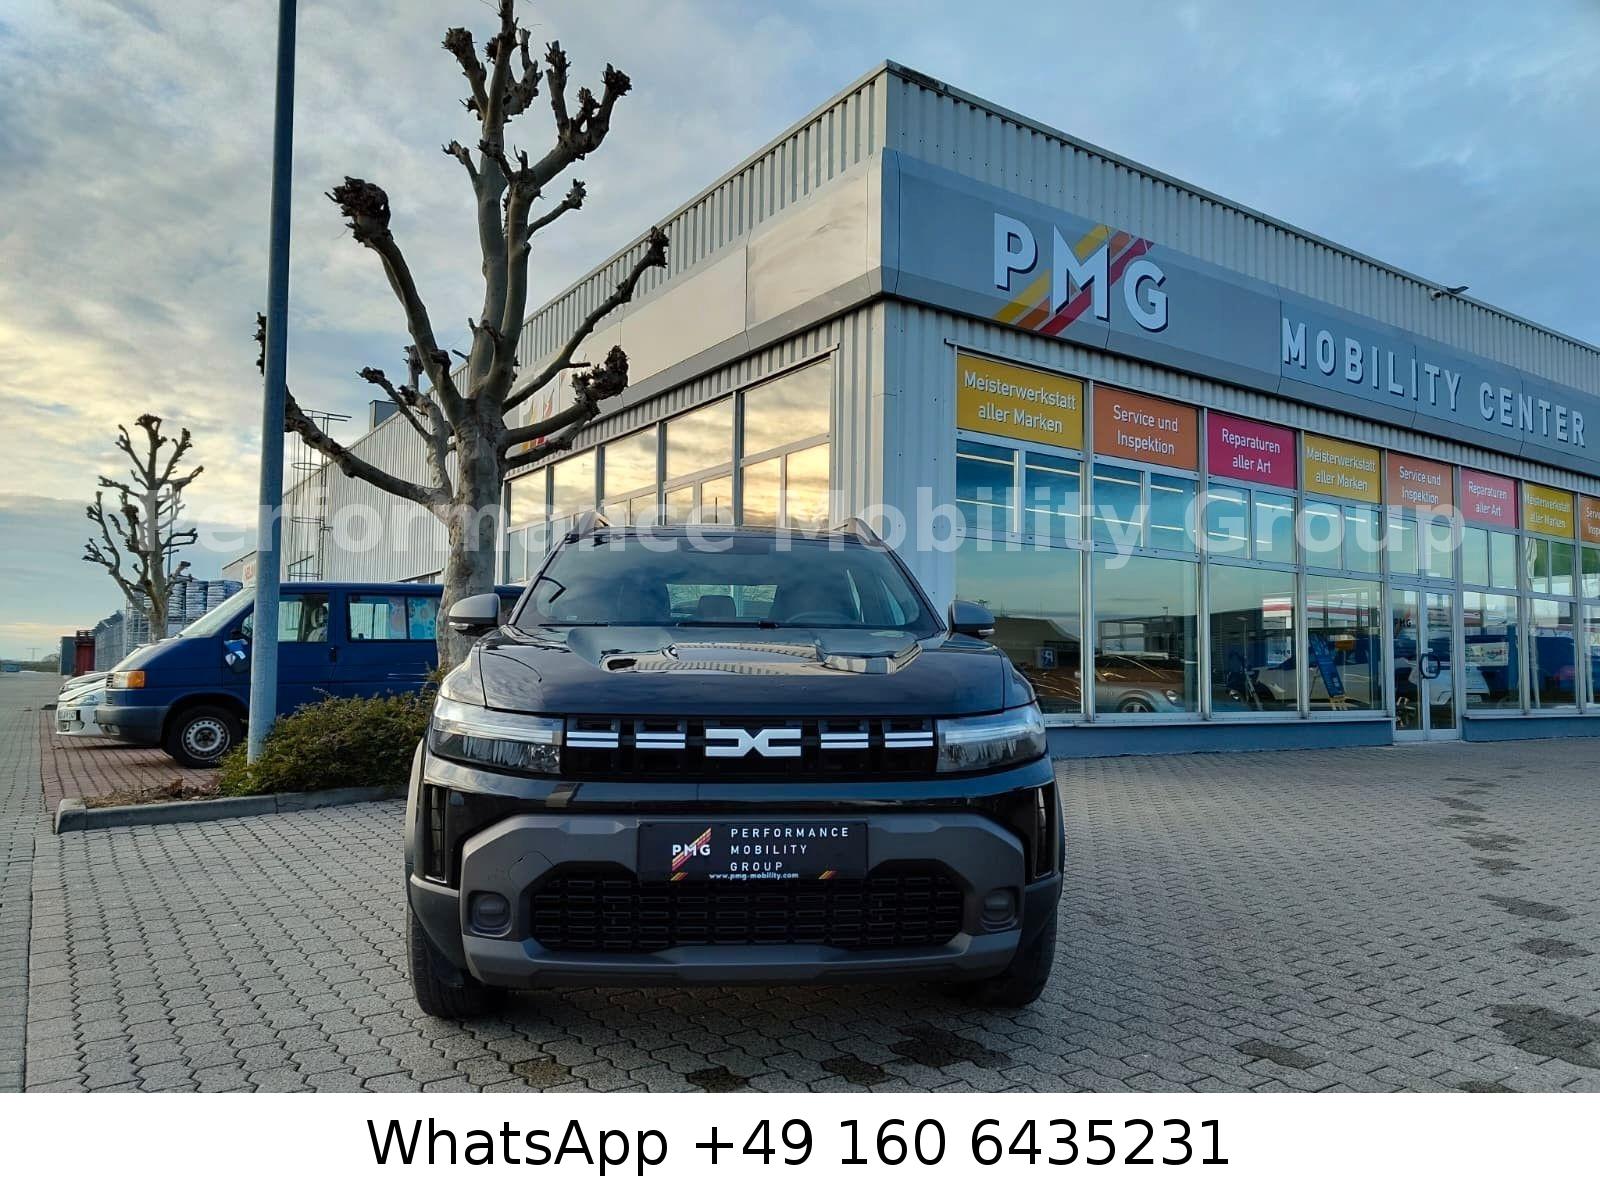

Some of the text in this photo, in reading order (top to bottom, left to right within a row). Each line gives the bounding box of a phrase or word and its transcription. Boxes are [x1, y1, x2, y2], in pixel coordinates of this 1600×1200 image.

[993, 211, 1169, 333] PMG
[964, 369, 1077, 411] Meisterwerkstatt
[1281, 317, 1587, 448] MOBILITY CENTER
[977, 402, 1063, 433] aller Marken
[1113, 404, 1179, 432] Service und
[1116, 429, 1175, 456] Inspektion
[1221, 428, 1281, 454] Reparaturen
[1232, 454, 1271, 474] aller Art
[1306, 446, 1377, 473] Meisterwerkstatt
[1315, 469, 1368, 492] aller Marken
[1399, 465, 1441, 486] Service und
[1402, 485, 1439, 505] Inspektion
[1468, 480, 1508, 500] Reparaturen
[730, 827, 849, 839] PERFORMANCE
[672, 844, 711, 857] PMG
[730, 844, 808, 855] MOBILITY
[709, 871, 799, 881] www.pmg-mobility.com
[730, 861, 783, 872] GROUP
